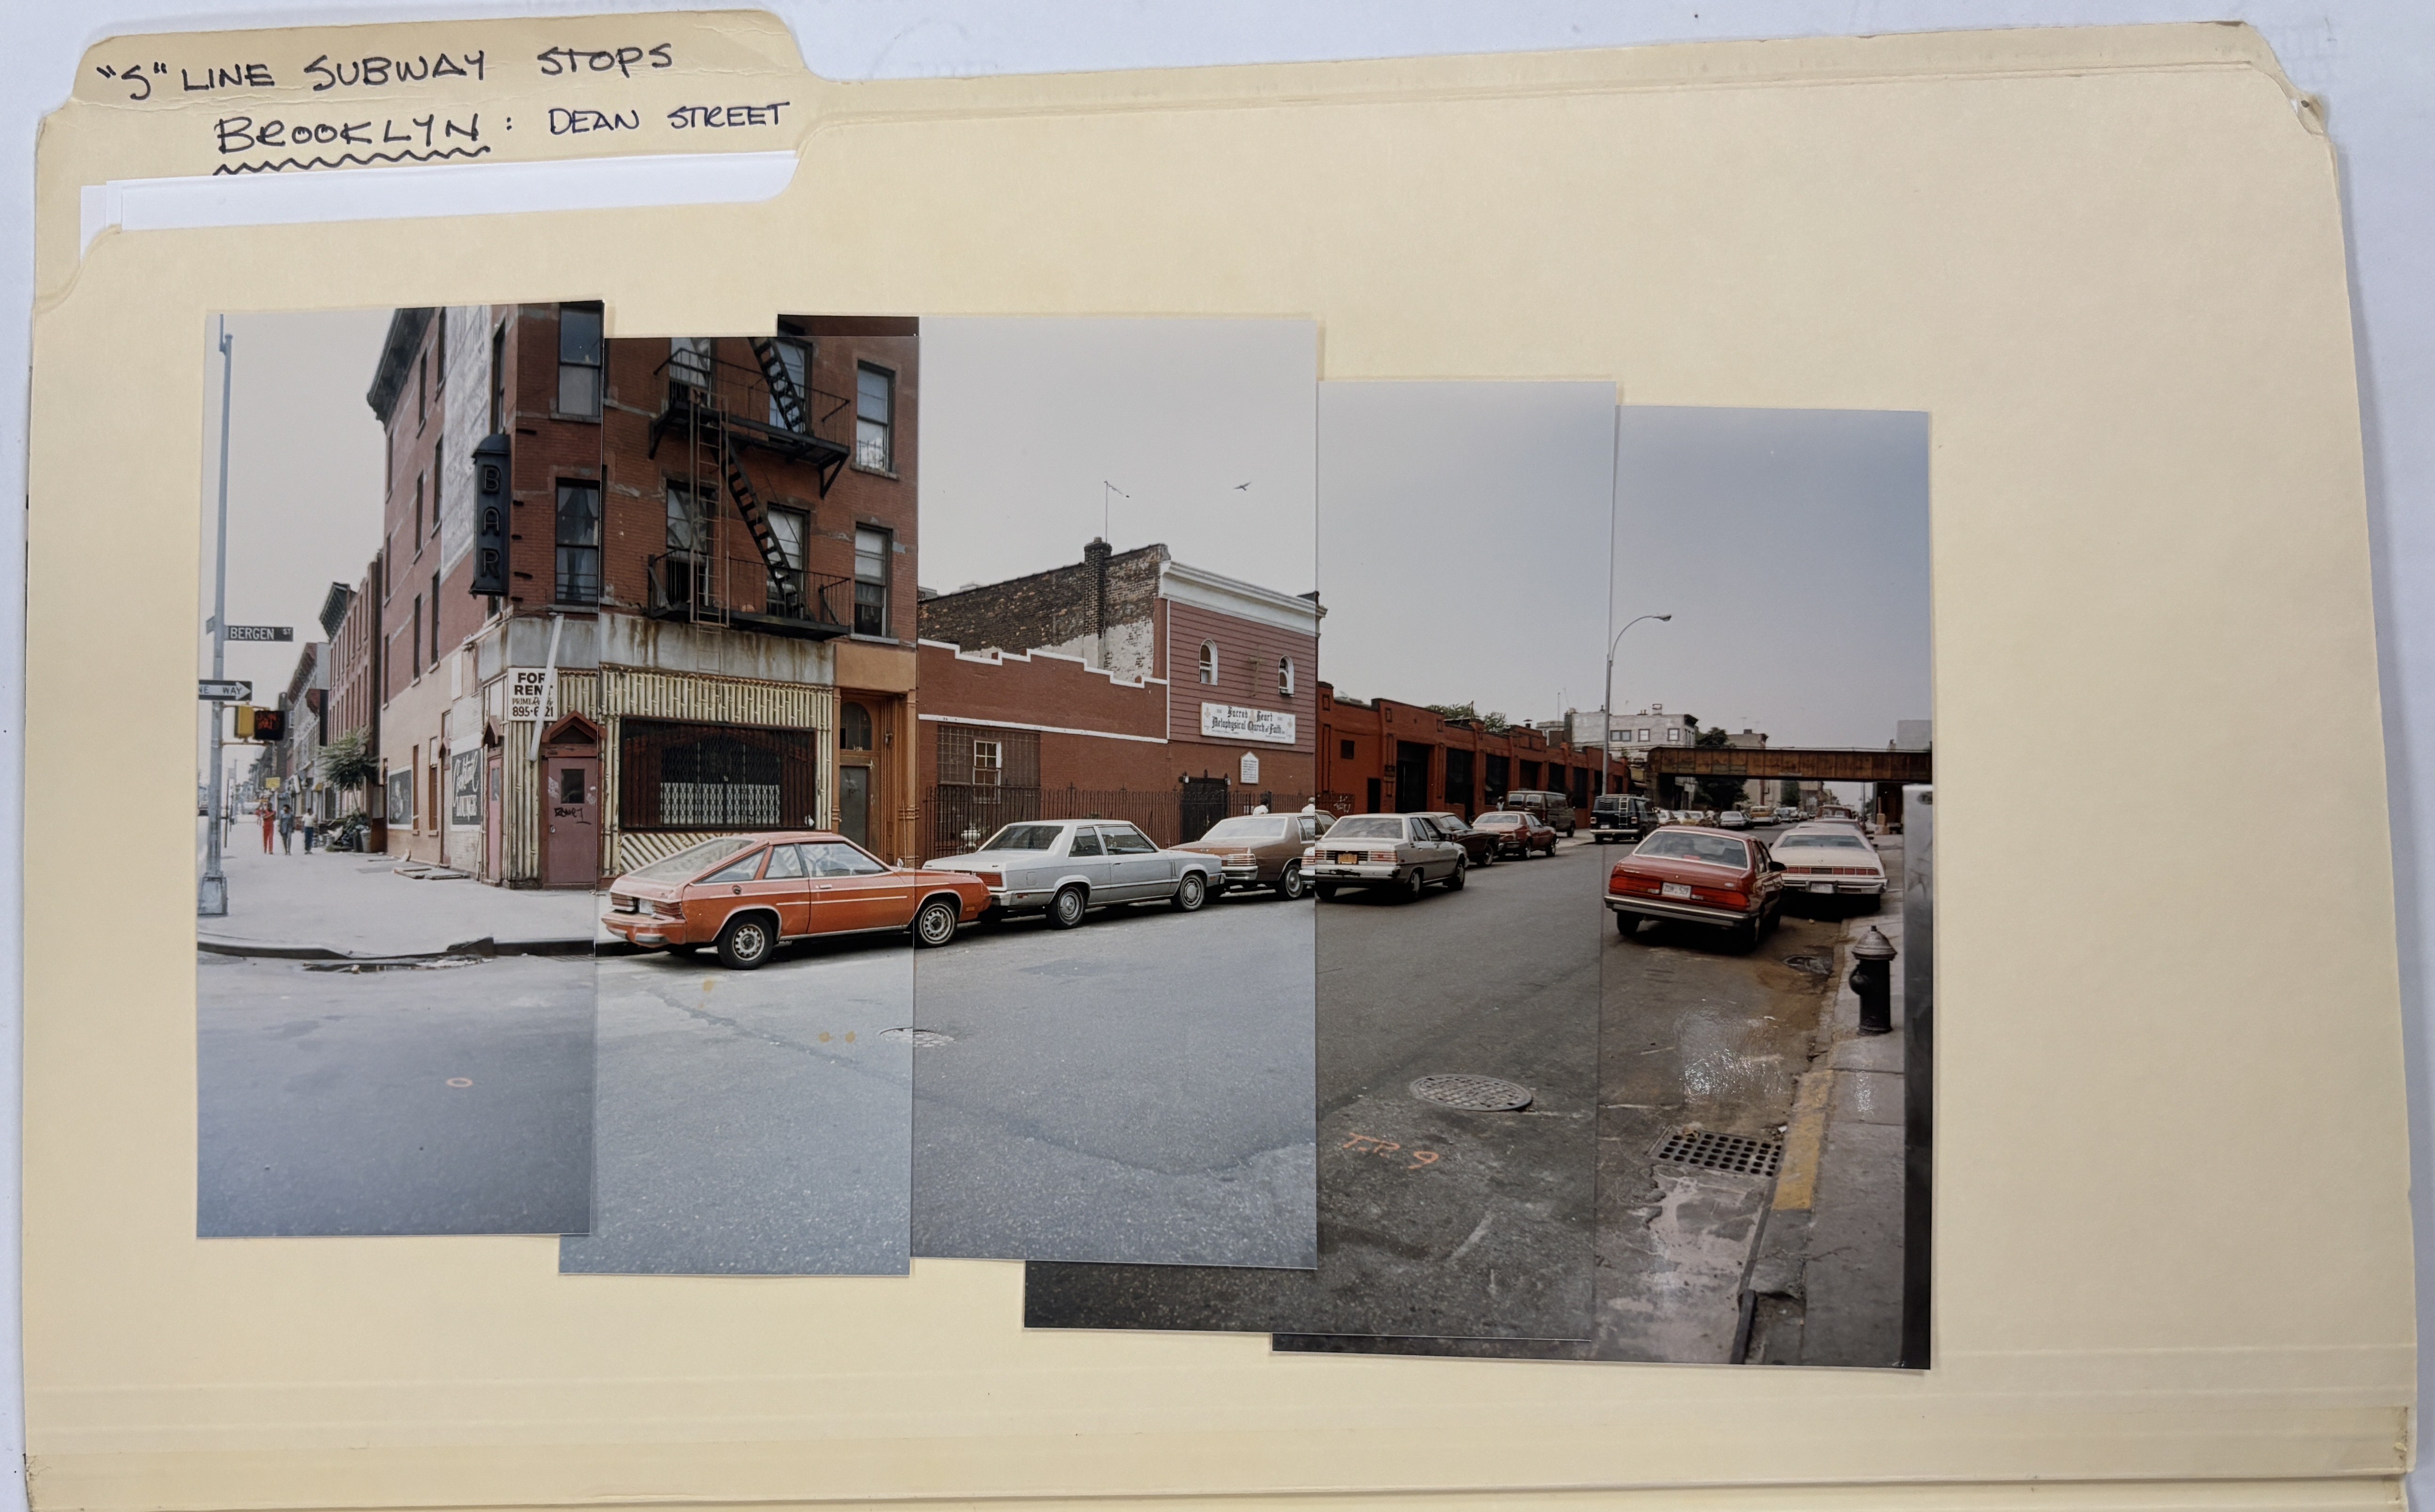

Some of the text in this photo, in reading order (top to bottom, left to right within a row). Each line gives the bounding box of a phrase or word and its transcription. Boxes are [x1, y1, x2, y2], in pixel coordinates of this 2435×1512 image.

[181, 63, 275, 91] LINE
[304, 50, 485, 92] SUBWAY
[537, 43, 672, 78] STOPS
[549, 108, 640, 135] DEAN
[667, 101, 790, 129] STREET
[481, 464, 501, 580] BAR
[230, 627, 275, 640] BERGEN
[199, 685, 242, 695] NE WAY
[514, 684, 553, 696] REN
[1227, 706, 1248, 719] Sacred
[1247, 720, 1264, 732] Church
[1407, 1150, 1439, 1169] 9
